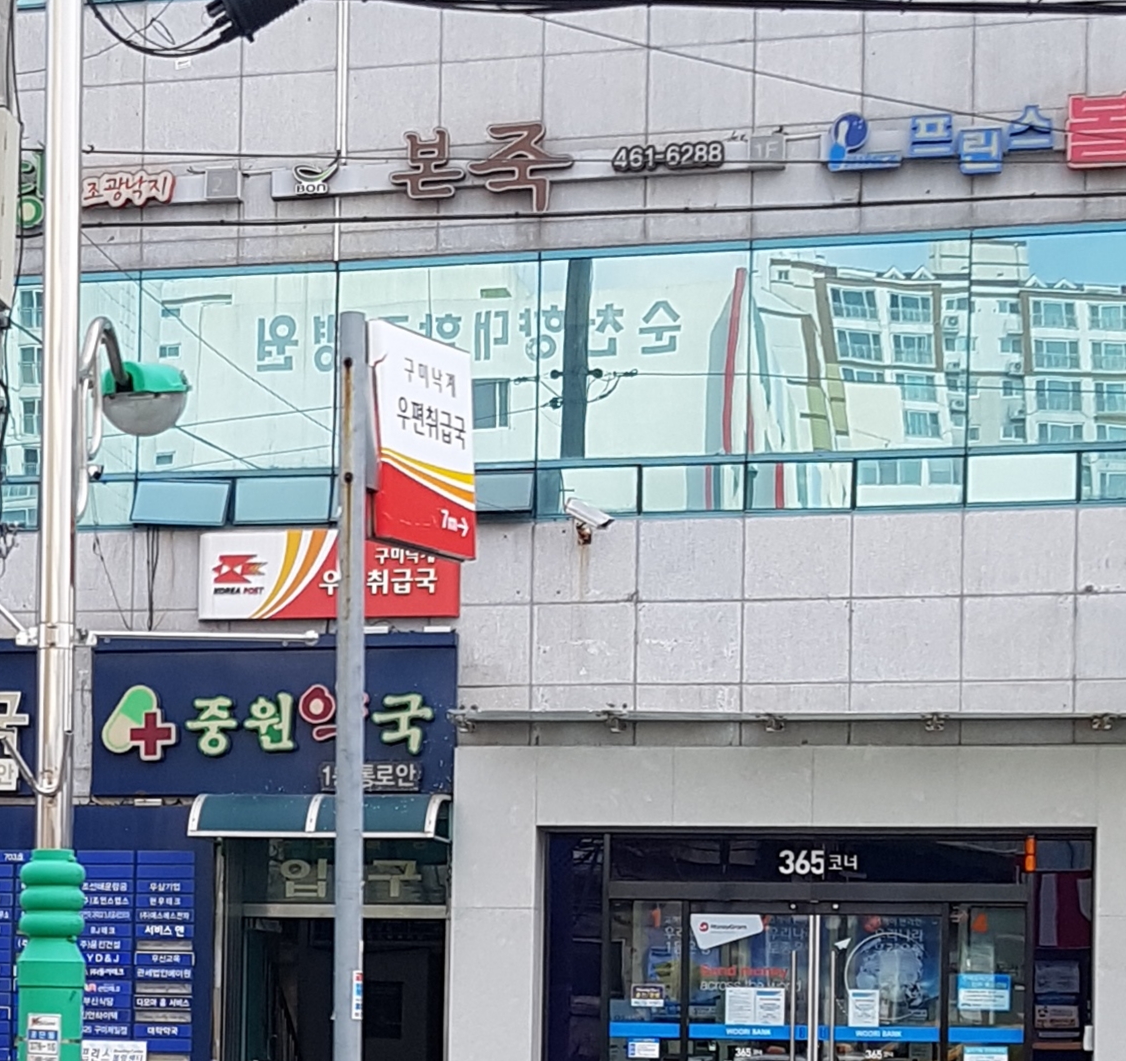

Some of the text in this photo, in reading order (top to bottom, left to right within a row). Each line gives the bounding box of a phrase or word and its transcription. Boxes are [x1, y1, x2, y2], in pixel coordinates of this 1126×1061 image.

[755, 142, 778, 159] 1F
[612, 142, 724, 173] 461-6288
[390, 119, 574, 213] 본죽
[295, 183, 327, 195] BON
[403, 357, 457, 399] 구미낙계
[396, 396, 467, 451] 우편취급국
[213, 586, 265, 595] KOREA POST
[778, 849, 858, 875] 365 코너
[144, 925, 173, 936] 서비스
[725, 1028, 772, 1036] WOORI BANK
[855, 1030, 902, 1038] WOORI BANK
[734, 1047, 752, 1058] 365
[864, 1049, 883, 1060] 365
